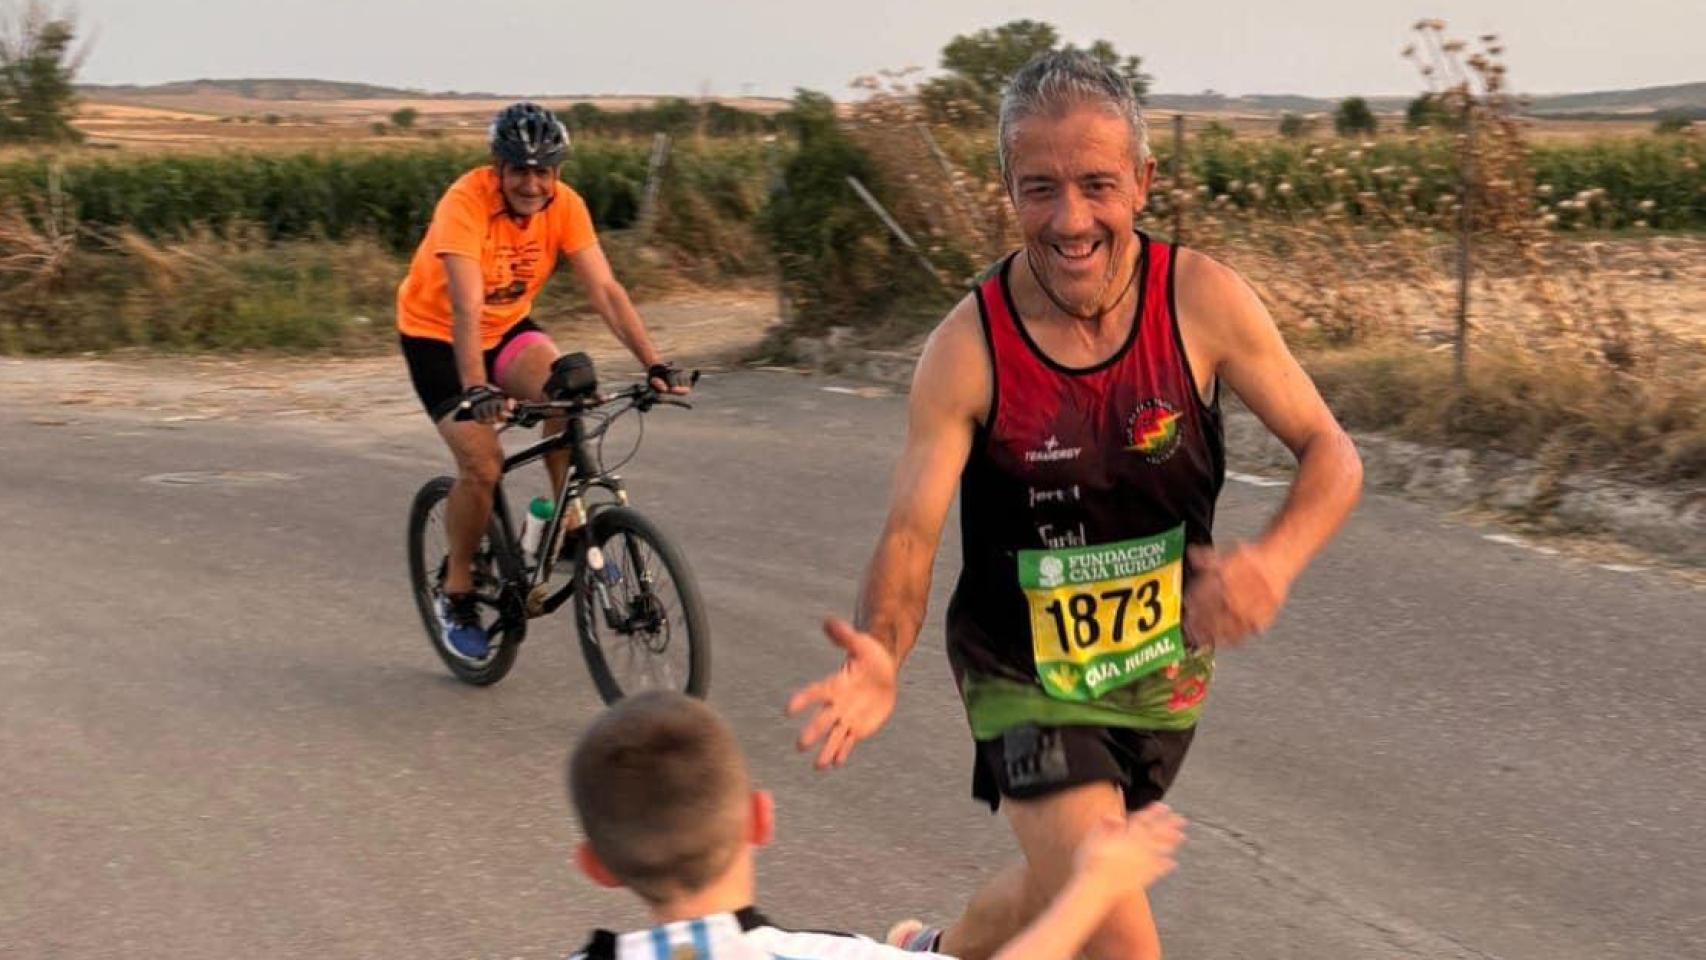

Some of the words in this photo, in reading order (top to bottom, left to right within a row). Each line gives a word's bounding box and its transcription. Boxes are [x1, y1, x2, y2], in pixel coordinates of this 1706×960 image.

[1069, 564, 1110, 582] CAJA
[1114, 553, 1164, 577] RURAL
[1045, 579, 1163, 655] 1873
[1085, 661, 1121, 688] CAJA
[1125, 637, 1176, 673] RURAL
